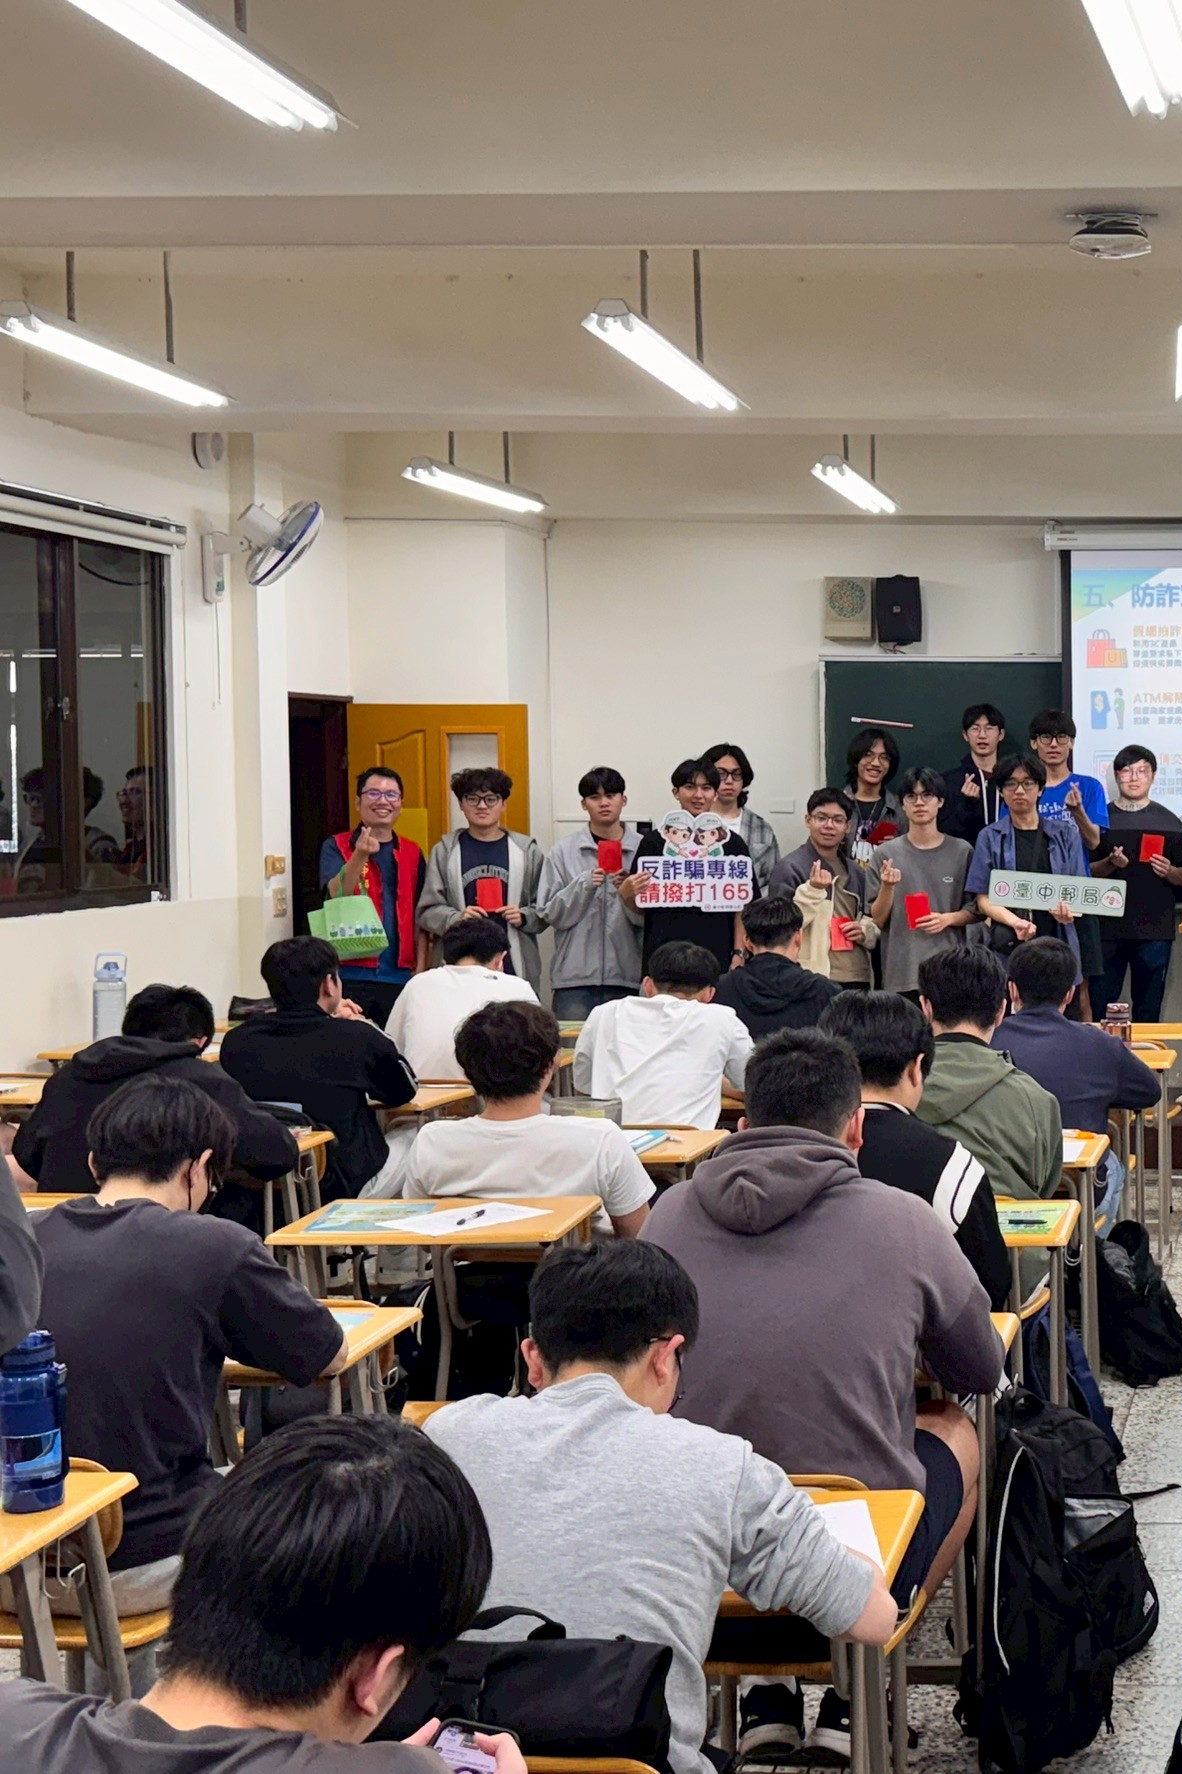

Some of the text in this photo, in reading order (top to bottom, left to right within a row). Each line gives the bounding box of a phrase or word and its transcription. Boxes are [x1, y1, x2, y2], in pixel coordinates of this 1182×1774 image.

[641, 860, 748, 880] 反詐騙專線
[640, 882, 750, 903] 請撥打165
